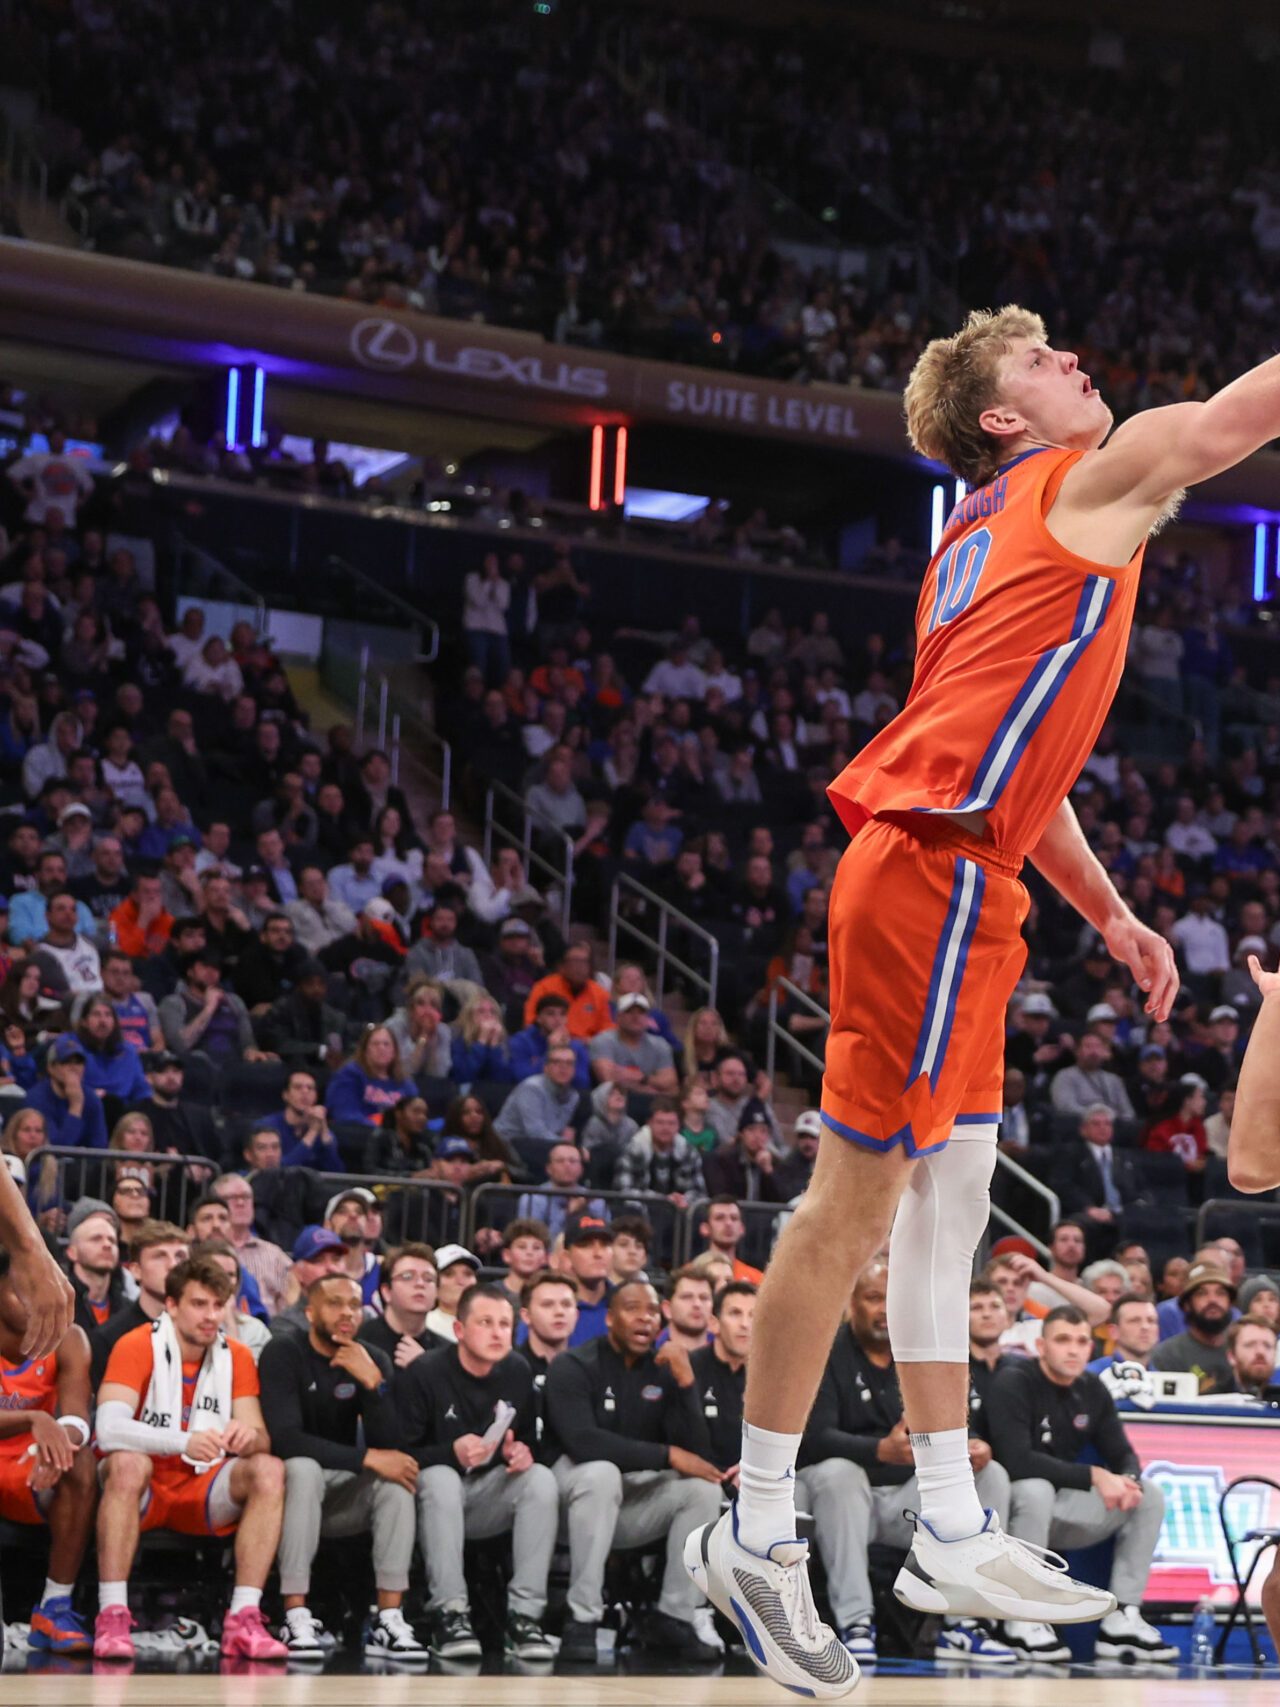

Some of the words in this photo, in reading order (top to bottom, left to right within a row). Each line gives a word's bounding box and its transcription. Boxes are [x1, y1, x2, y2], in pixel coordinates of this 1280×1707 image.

[424, 339, 609, 397] LEXUS
[667, 380, 759, 423] SUITE
[768, 396, 860, 439] LEVEL
[944, 476, 1008, 531] AUGH
[928, 527, 993, 635] 10
